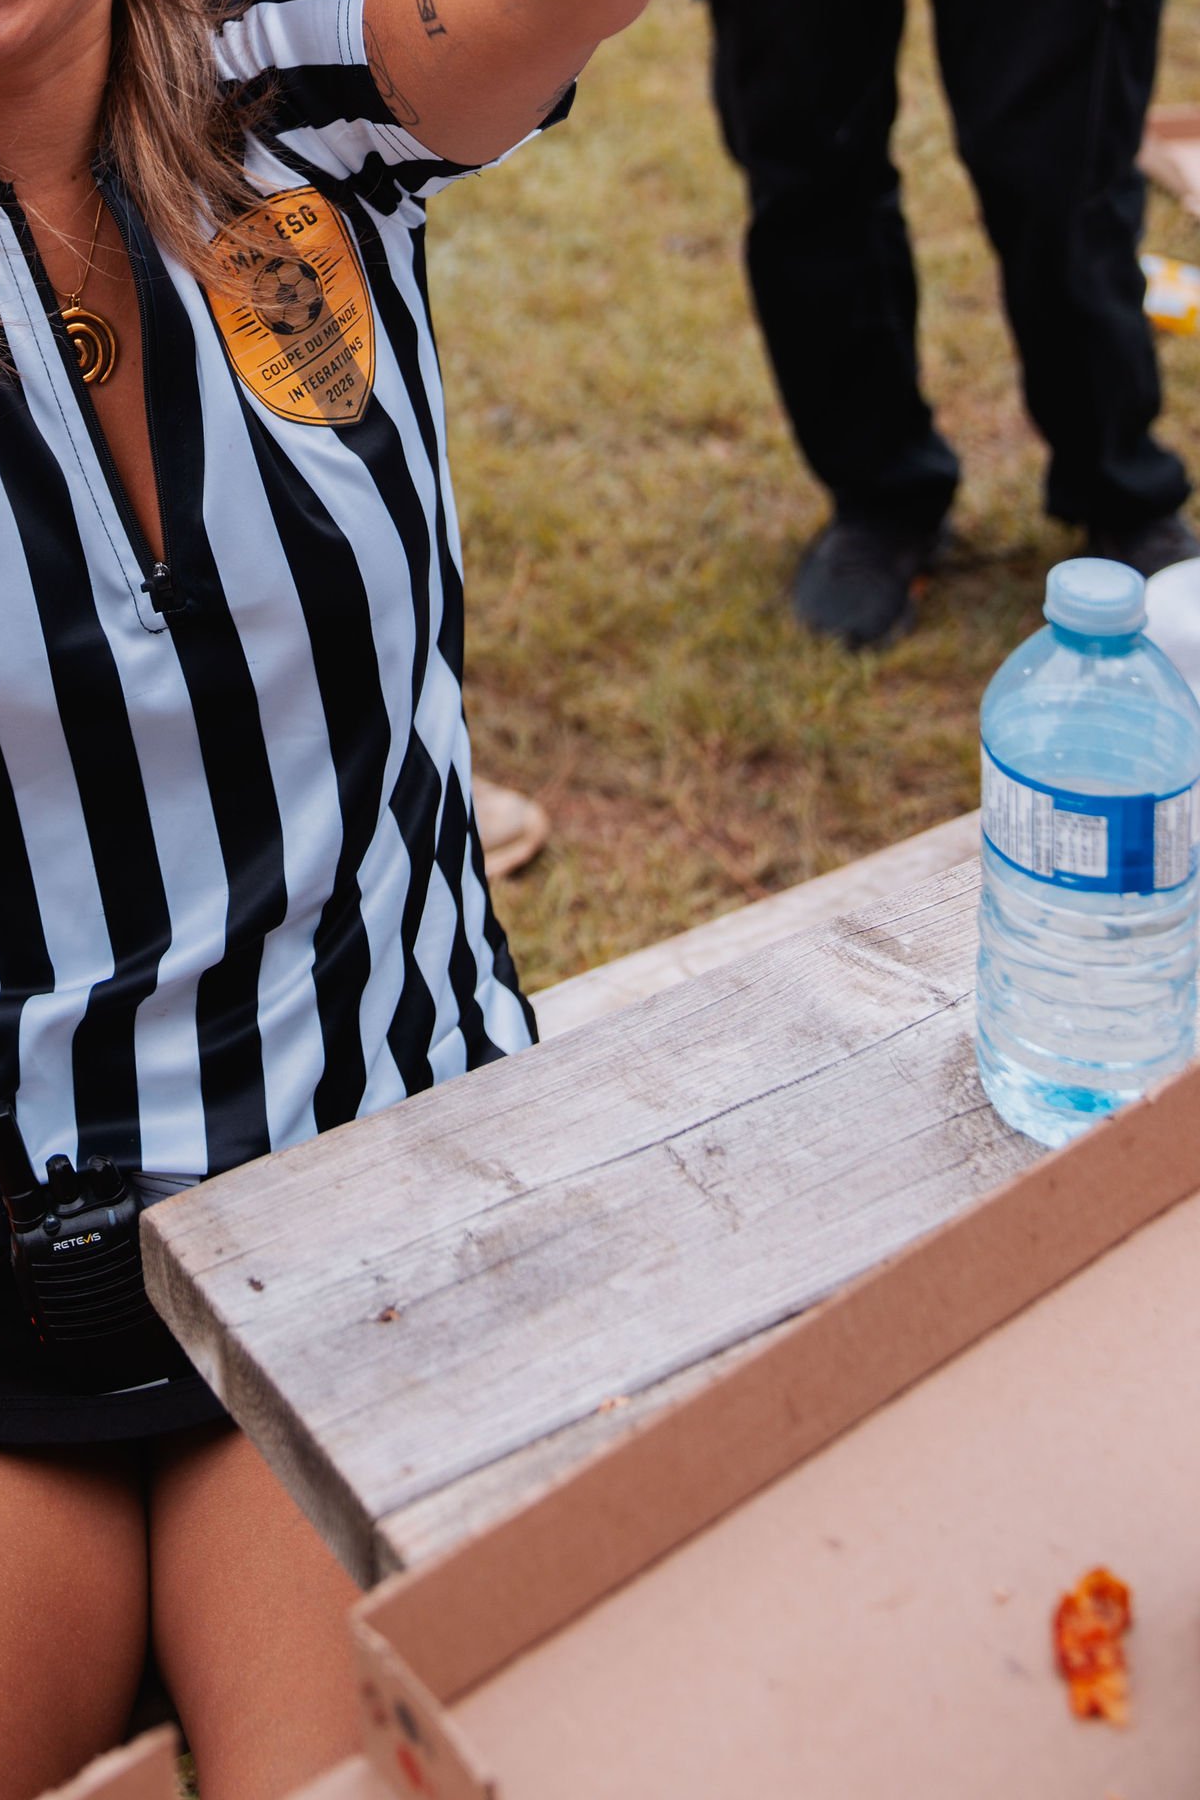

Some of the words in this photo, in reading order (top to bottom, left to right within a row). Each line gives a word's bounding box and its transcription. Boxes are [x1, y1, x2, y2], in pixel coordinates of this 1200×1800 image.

[274, 205, 319, 241] ESG
[262, 349, 306, 382] COUPE
[305, 335, 324, 354] DU
[325, 303, 359, 338] MONDE
[288, 336, 364, 403] INTÉGRATIONS
[326, 373, 356, 403] 2026
[53, 1232, 102, 1251] RETEVIS
